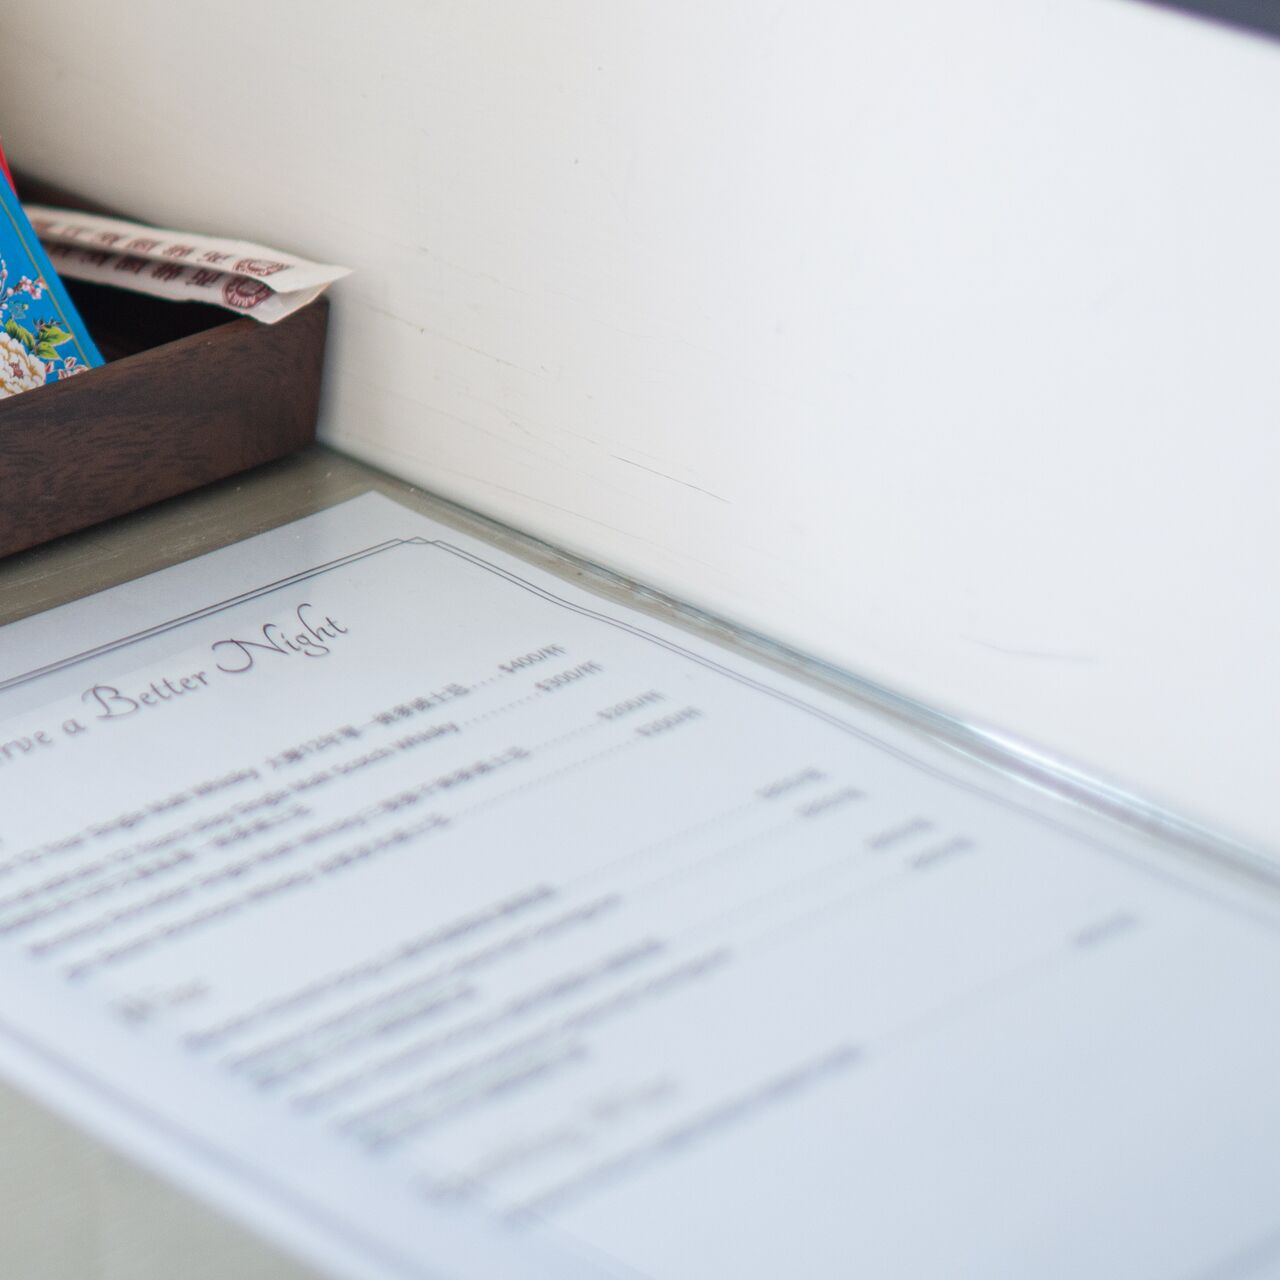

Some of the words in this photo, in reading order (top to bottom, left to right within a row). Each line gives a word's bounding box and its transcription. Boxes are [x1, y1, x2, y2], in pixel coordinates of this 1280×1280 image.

[61, 716, 87, 737] a
[82, 669, 210, 721] Better
[210, 602, 349, 674] Night
